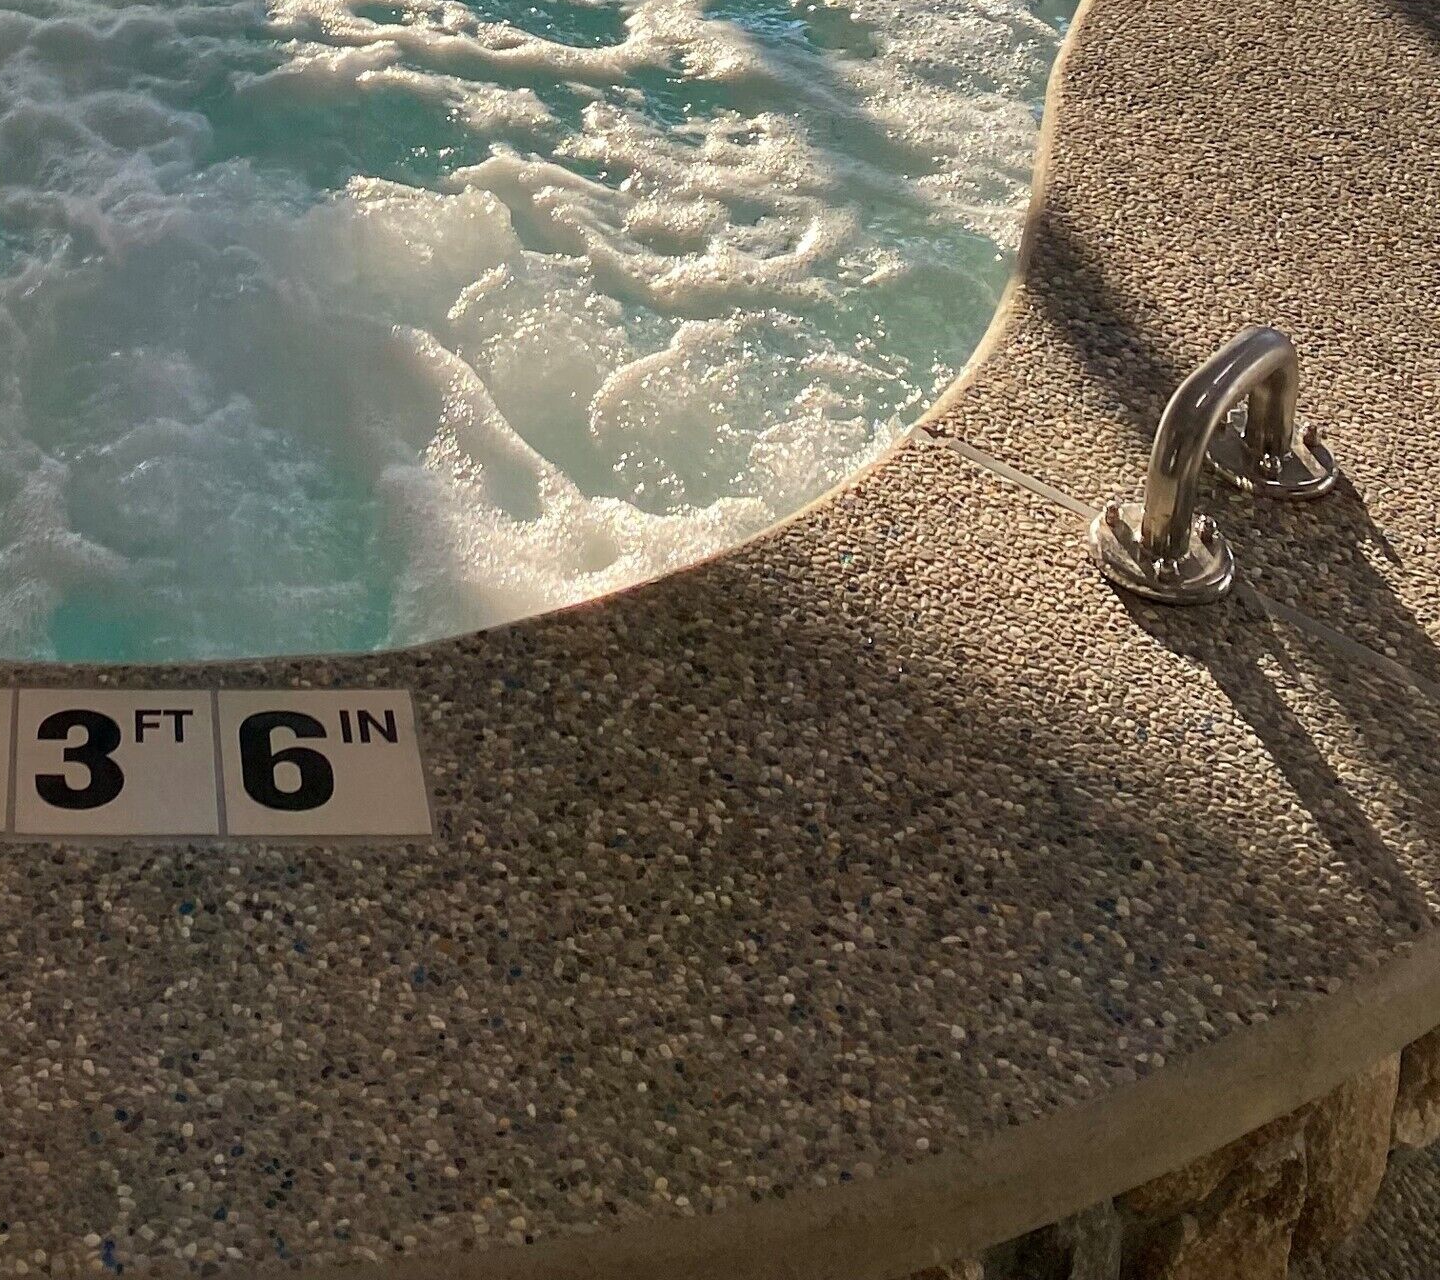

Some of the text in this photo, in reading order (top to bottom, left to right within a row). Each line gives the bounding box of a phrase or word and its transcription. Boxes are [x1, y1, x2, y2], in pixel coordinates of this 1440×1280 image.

[35, 709, 399, 812] 3 FT 6 IN
